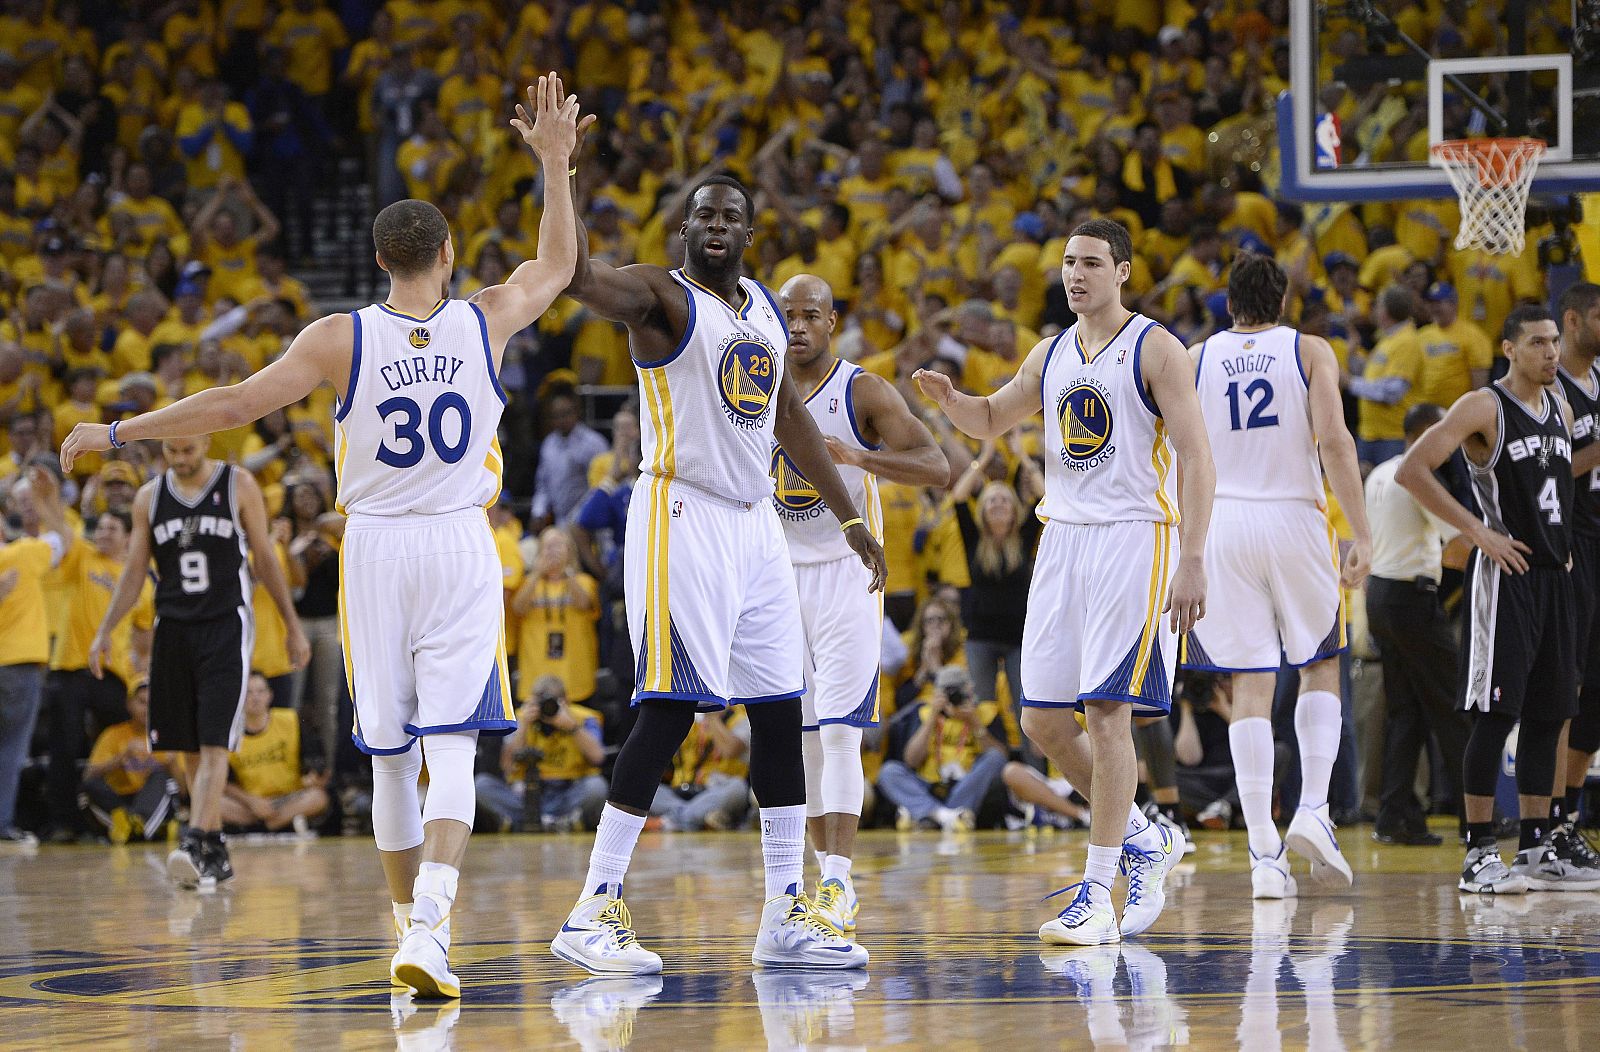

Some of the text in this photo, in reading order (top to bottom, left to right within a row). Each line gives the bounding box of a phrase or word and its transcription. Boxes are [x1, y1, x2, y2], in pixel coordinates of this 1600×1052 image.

[717, 332, 750, 351] GOLDEN
[380, 355, 463, 391] CURRY
[749, 355, 770, 377] 23
[1222, 354, 1276, 377] BOGUT
[1055, 376, 1112, 404] GOLDEN STATE
[720, 398, 771, 431] WARRIORS
[1083, 398, 1095, 418] 11
[1225, 379, 1280, 432] 12
[375, 392, 471, 468] 30
[1060, 443, 1116, 472] WARRIORS
[772, 499, 830, 522] WARRIOR
[1537, 476, 1563, 525] 4
[179, 550, 210, 595] 9
